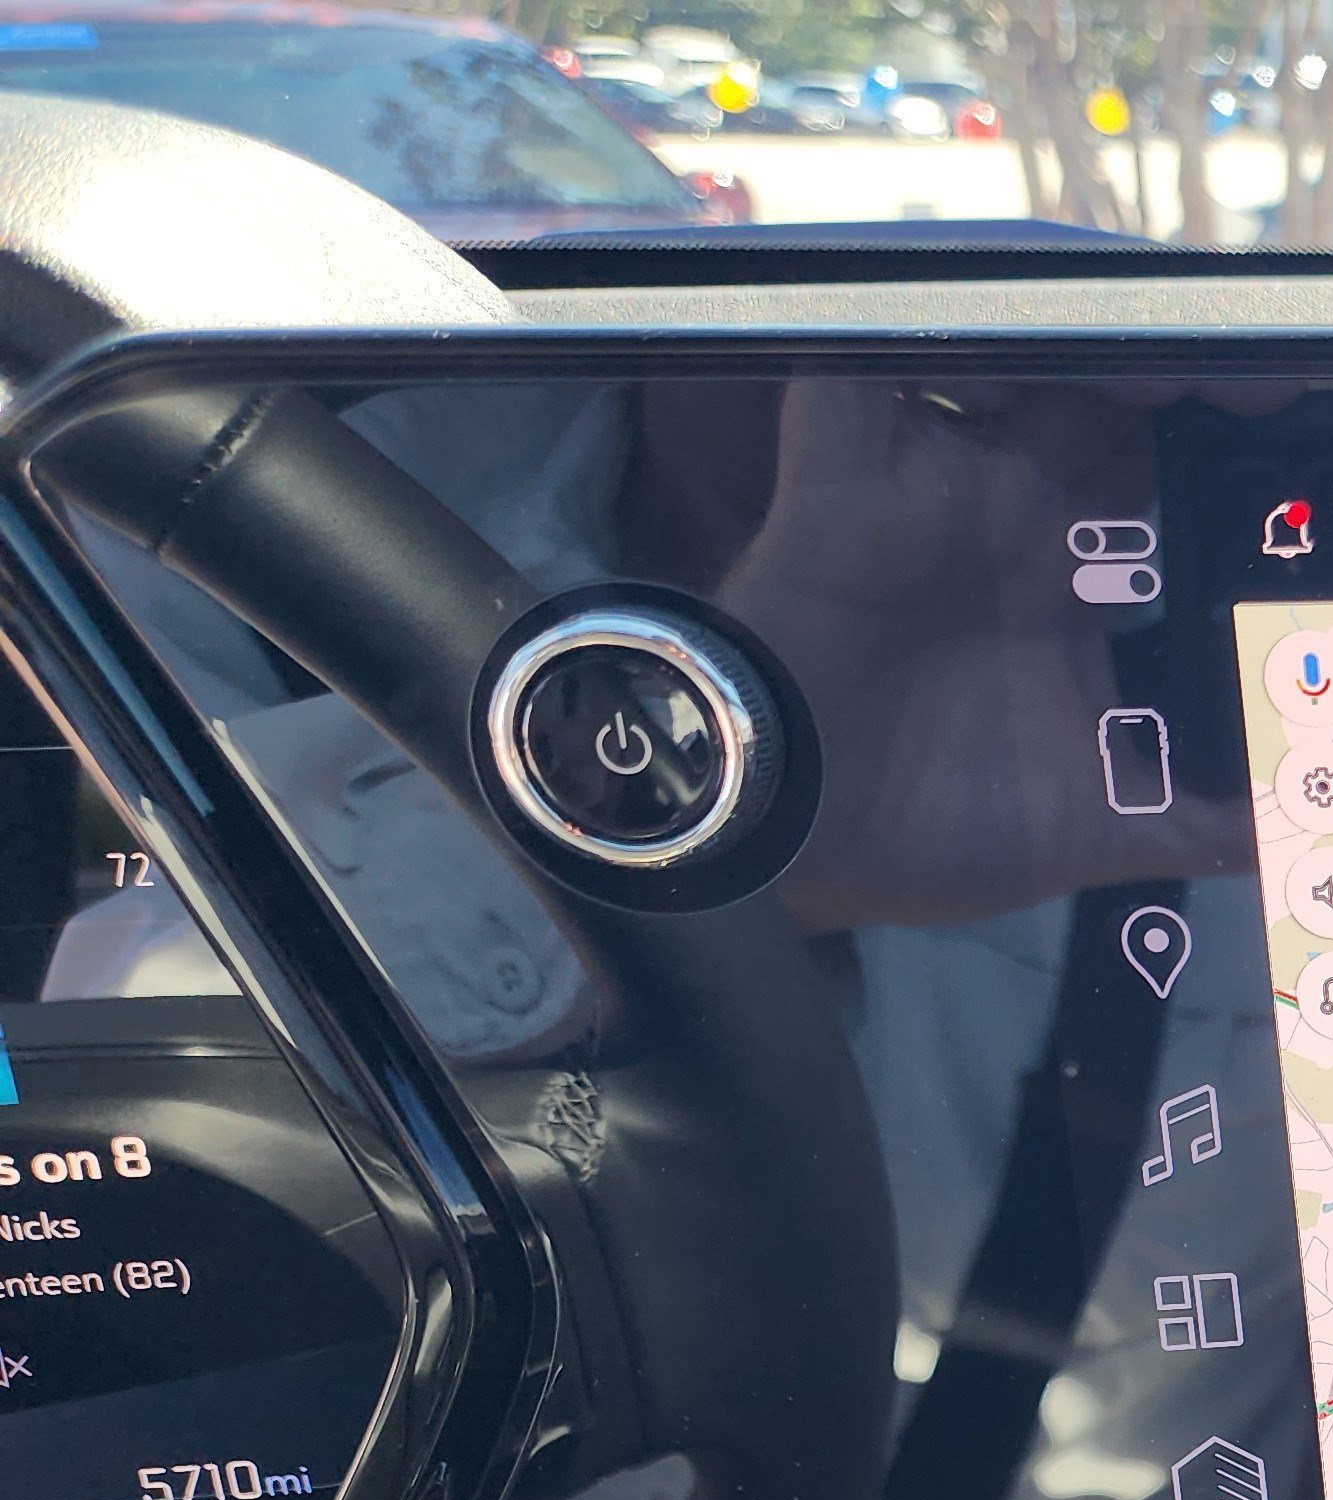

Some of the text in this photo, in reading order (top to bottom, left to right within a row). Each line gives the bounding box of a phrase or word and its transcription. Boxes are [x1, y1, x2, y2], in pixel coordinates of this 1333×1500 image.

[105, 852, 154, 888] 72
[31, 1151, 103, 1184] on
[111, 1136, 151, 1178] 8
[0, 1258, 190, 1298] nteen (82)
